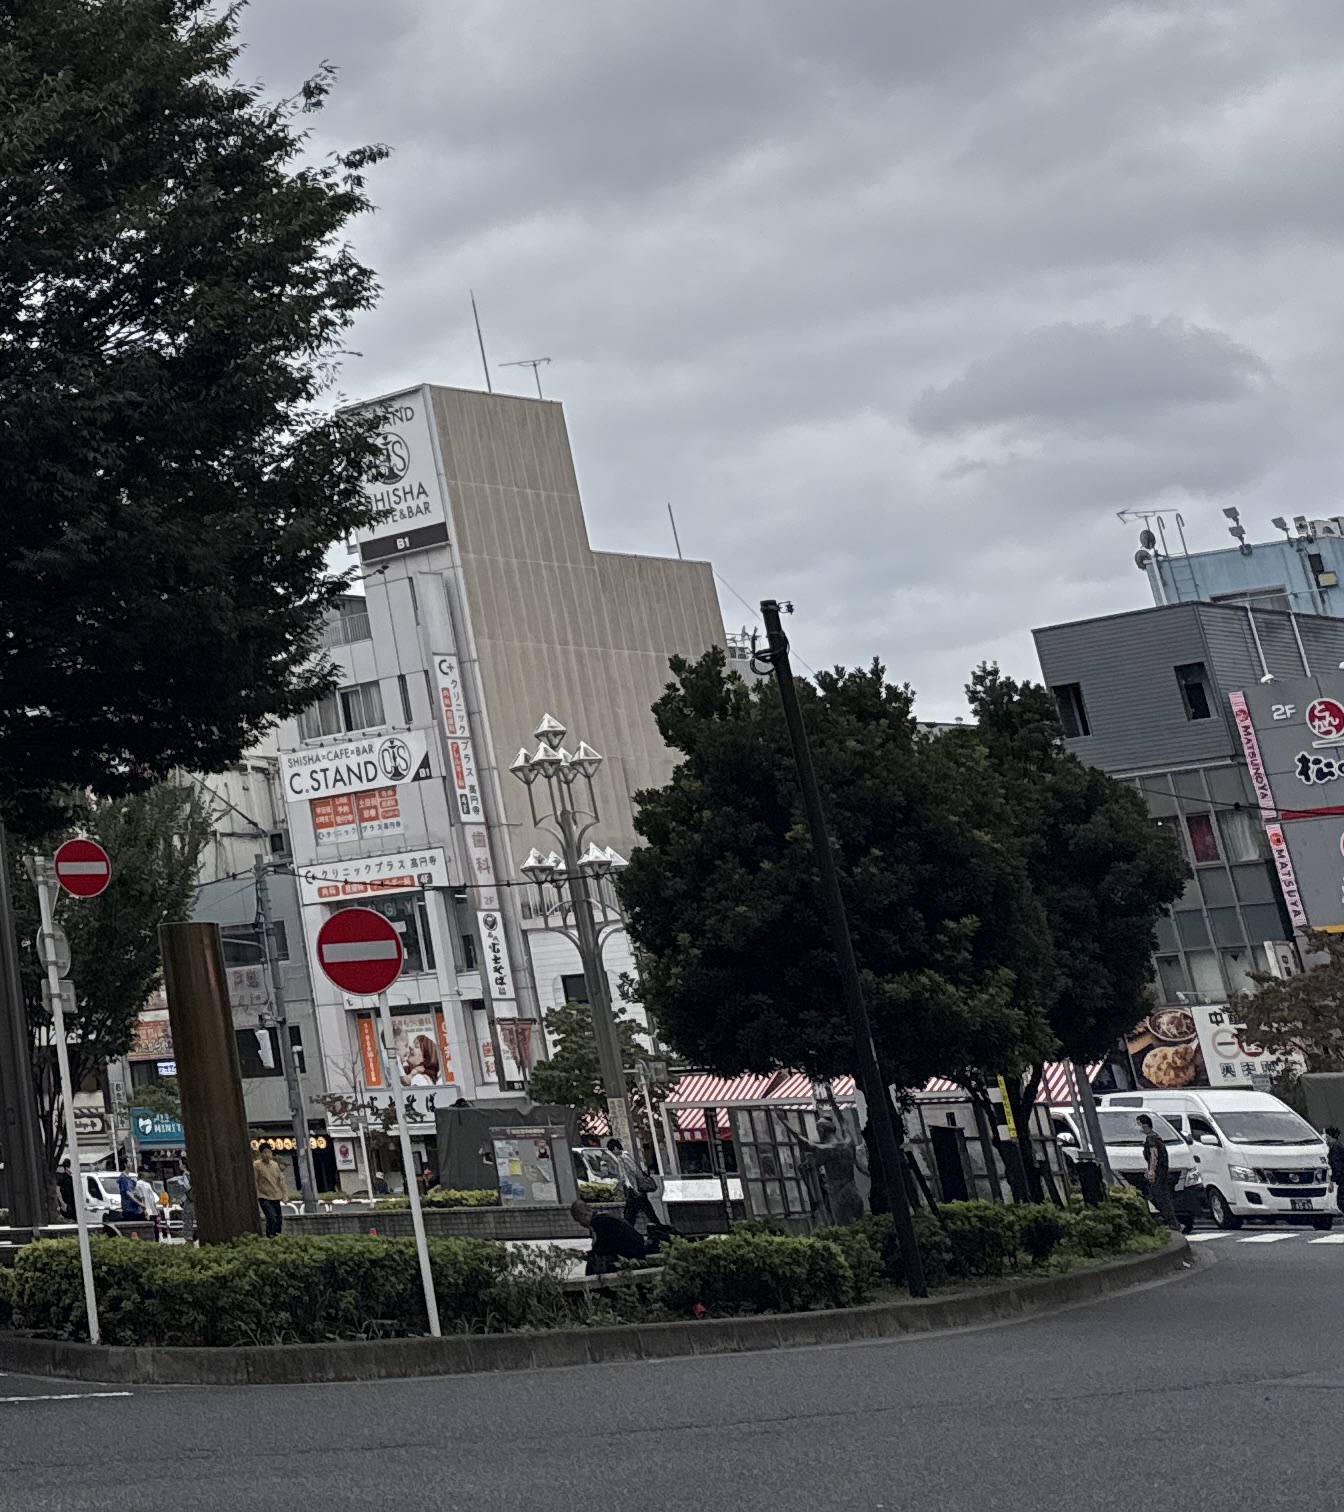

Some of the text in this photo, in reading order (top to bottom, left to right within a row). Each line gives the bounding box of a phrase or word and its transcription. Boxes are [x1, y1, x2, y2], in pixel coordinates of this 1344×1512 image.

[396, 537, 410, 549] B1
[1272, 705, 1297, 720] 2F
[418, 768, 431, 777] B1
[1242, 724, 1269, 799] MATSUNOYA
[1296, 753, 1344, 783] 松
[289, 760, 378, 795] C.STAND
[410, 855, 436, 868] 高円寺
[472, 831, 490, 874] 歯科
[1275, 848, 1303, 921] MATSUYA
[484, 896, 495, 905] 2F
